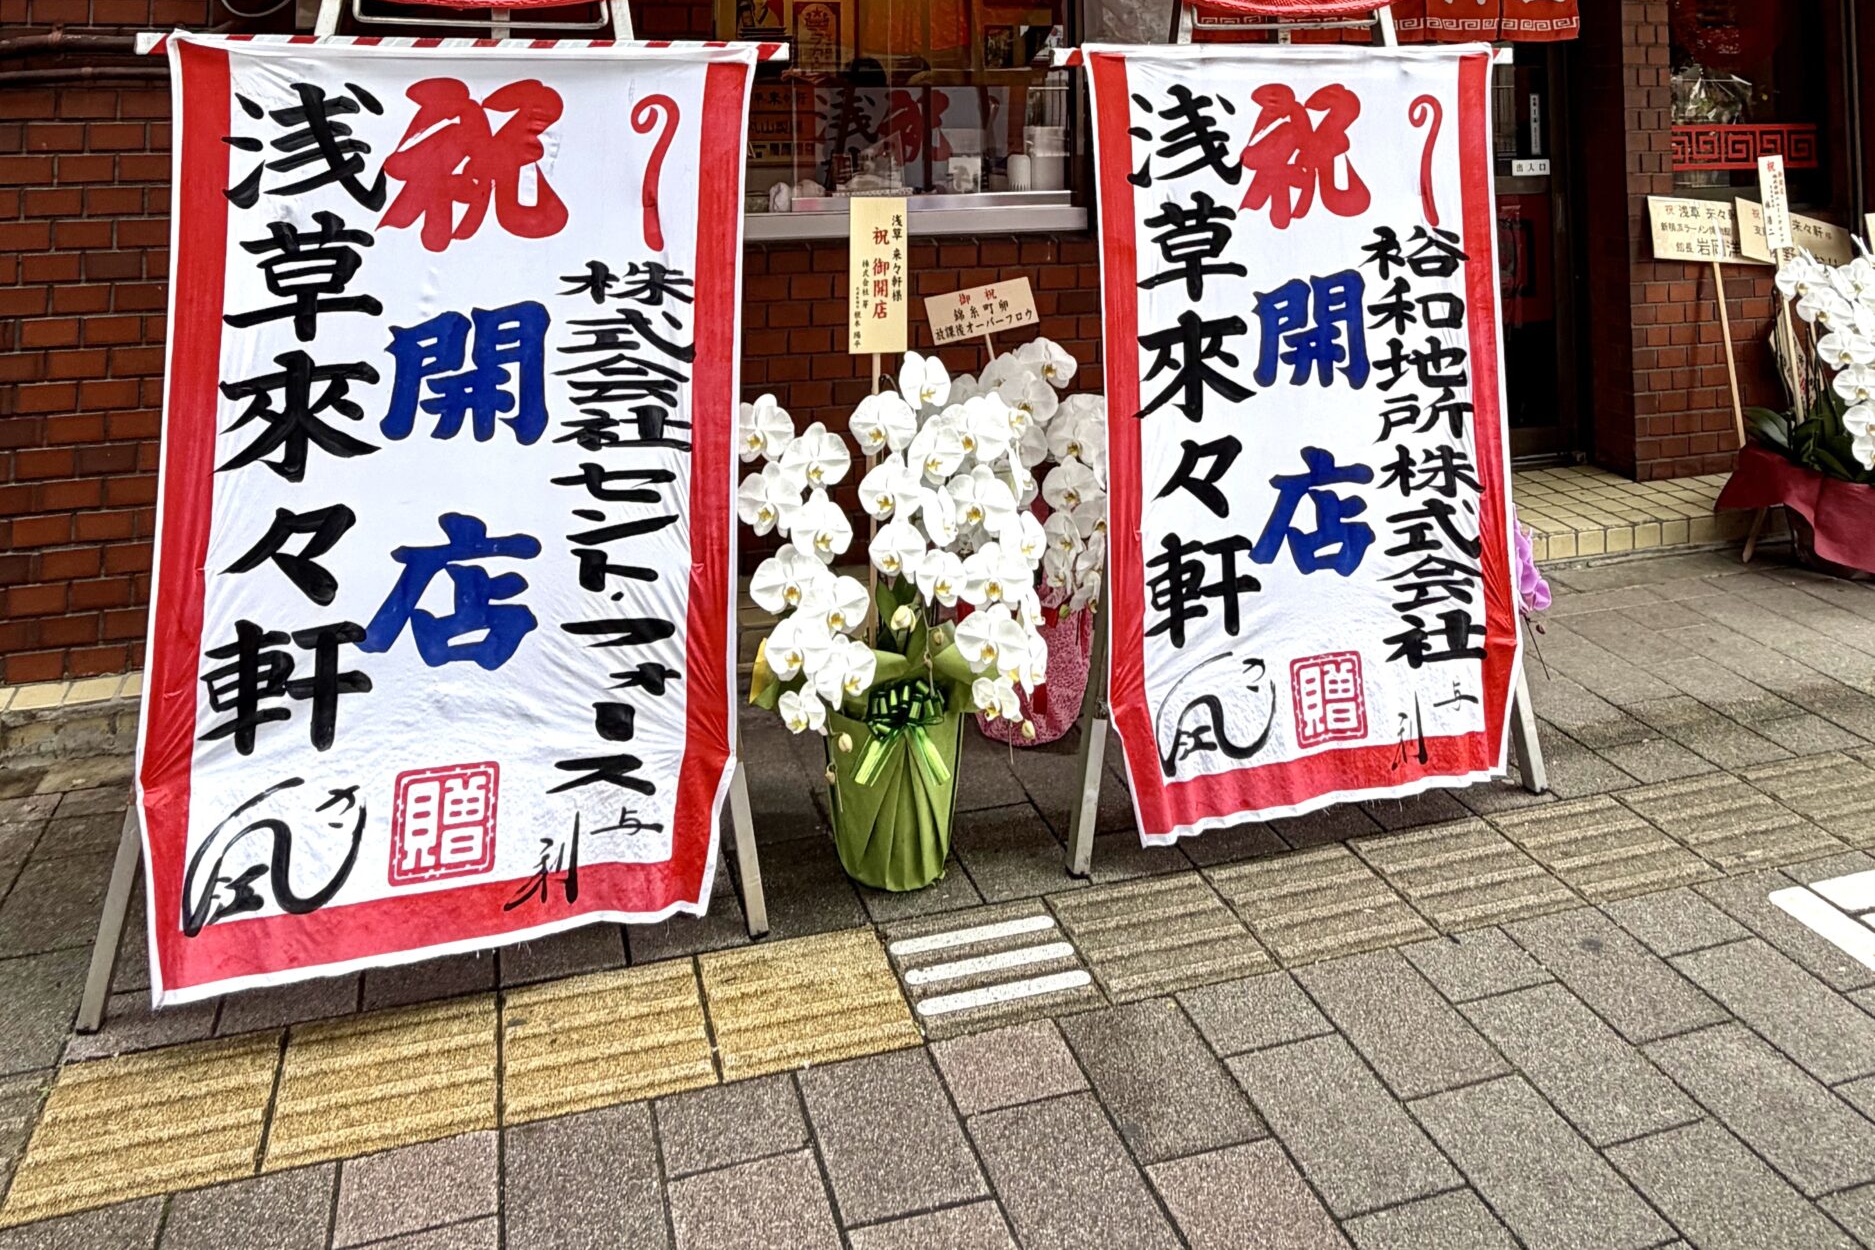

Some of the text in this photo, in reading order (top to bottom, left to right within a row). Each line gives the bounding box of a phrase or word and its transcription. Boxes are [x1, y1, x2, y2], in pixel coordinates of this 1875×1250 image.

[872, 226, 890, 319] 祝 御開店
[891, 214, 903, 302] 浅草 来々軒様
[1358, 225, 1488, 668] 裕和地所株式会社
[1297, 658, 1362, 740] 贈
[398, 770, 492, 875] 贈
